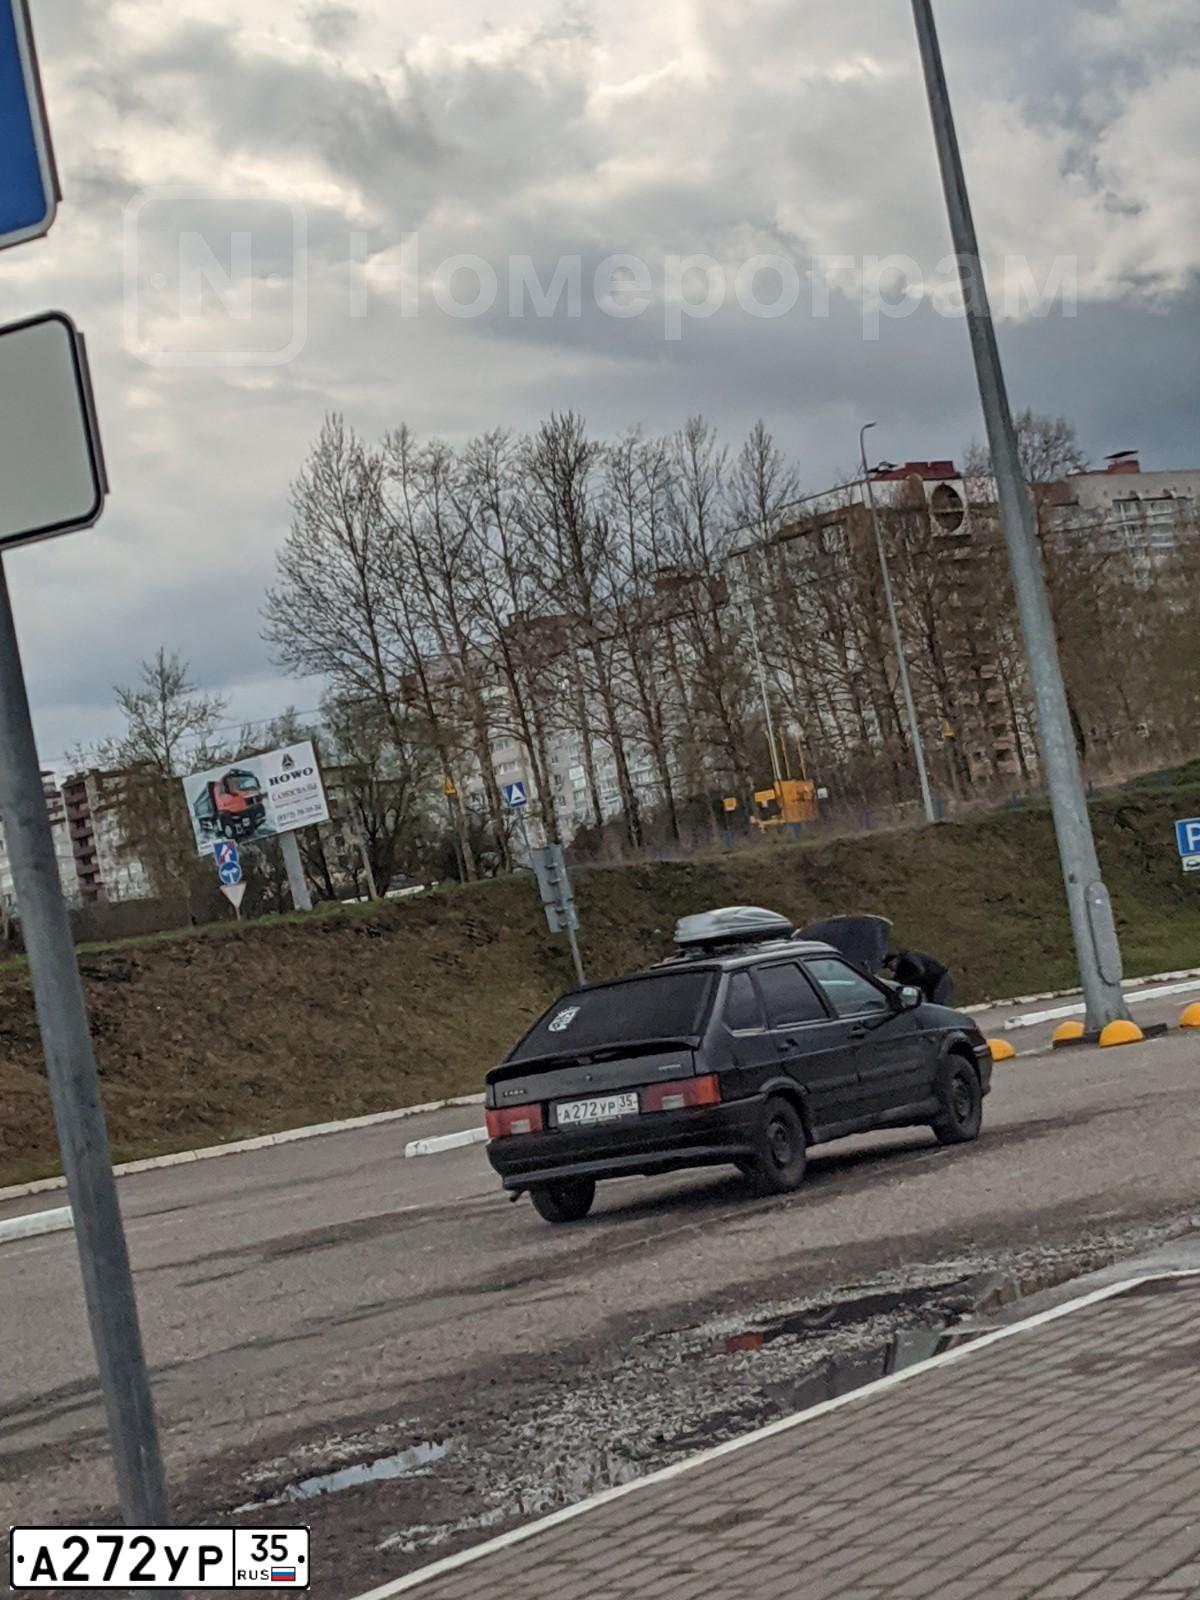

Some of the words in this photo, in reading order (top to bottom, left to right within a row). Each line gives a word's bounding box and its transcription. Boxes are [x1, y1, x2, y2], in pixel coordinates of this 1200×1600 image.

[268, 767, 314, 787] HOWO
[563, 1101, 616, 1121] А272УР
[619, 1095, 633, 1108] 35
